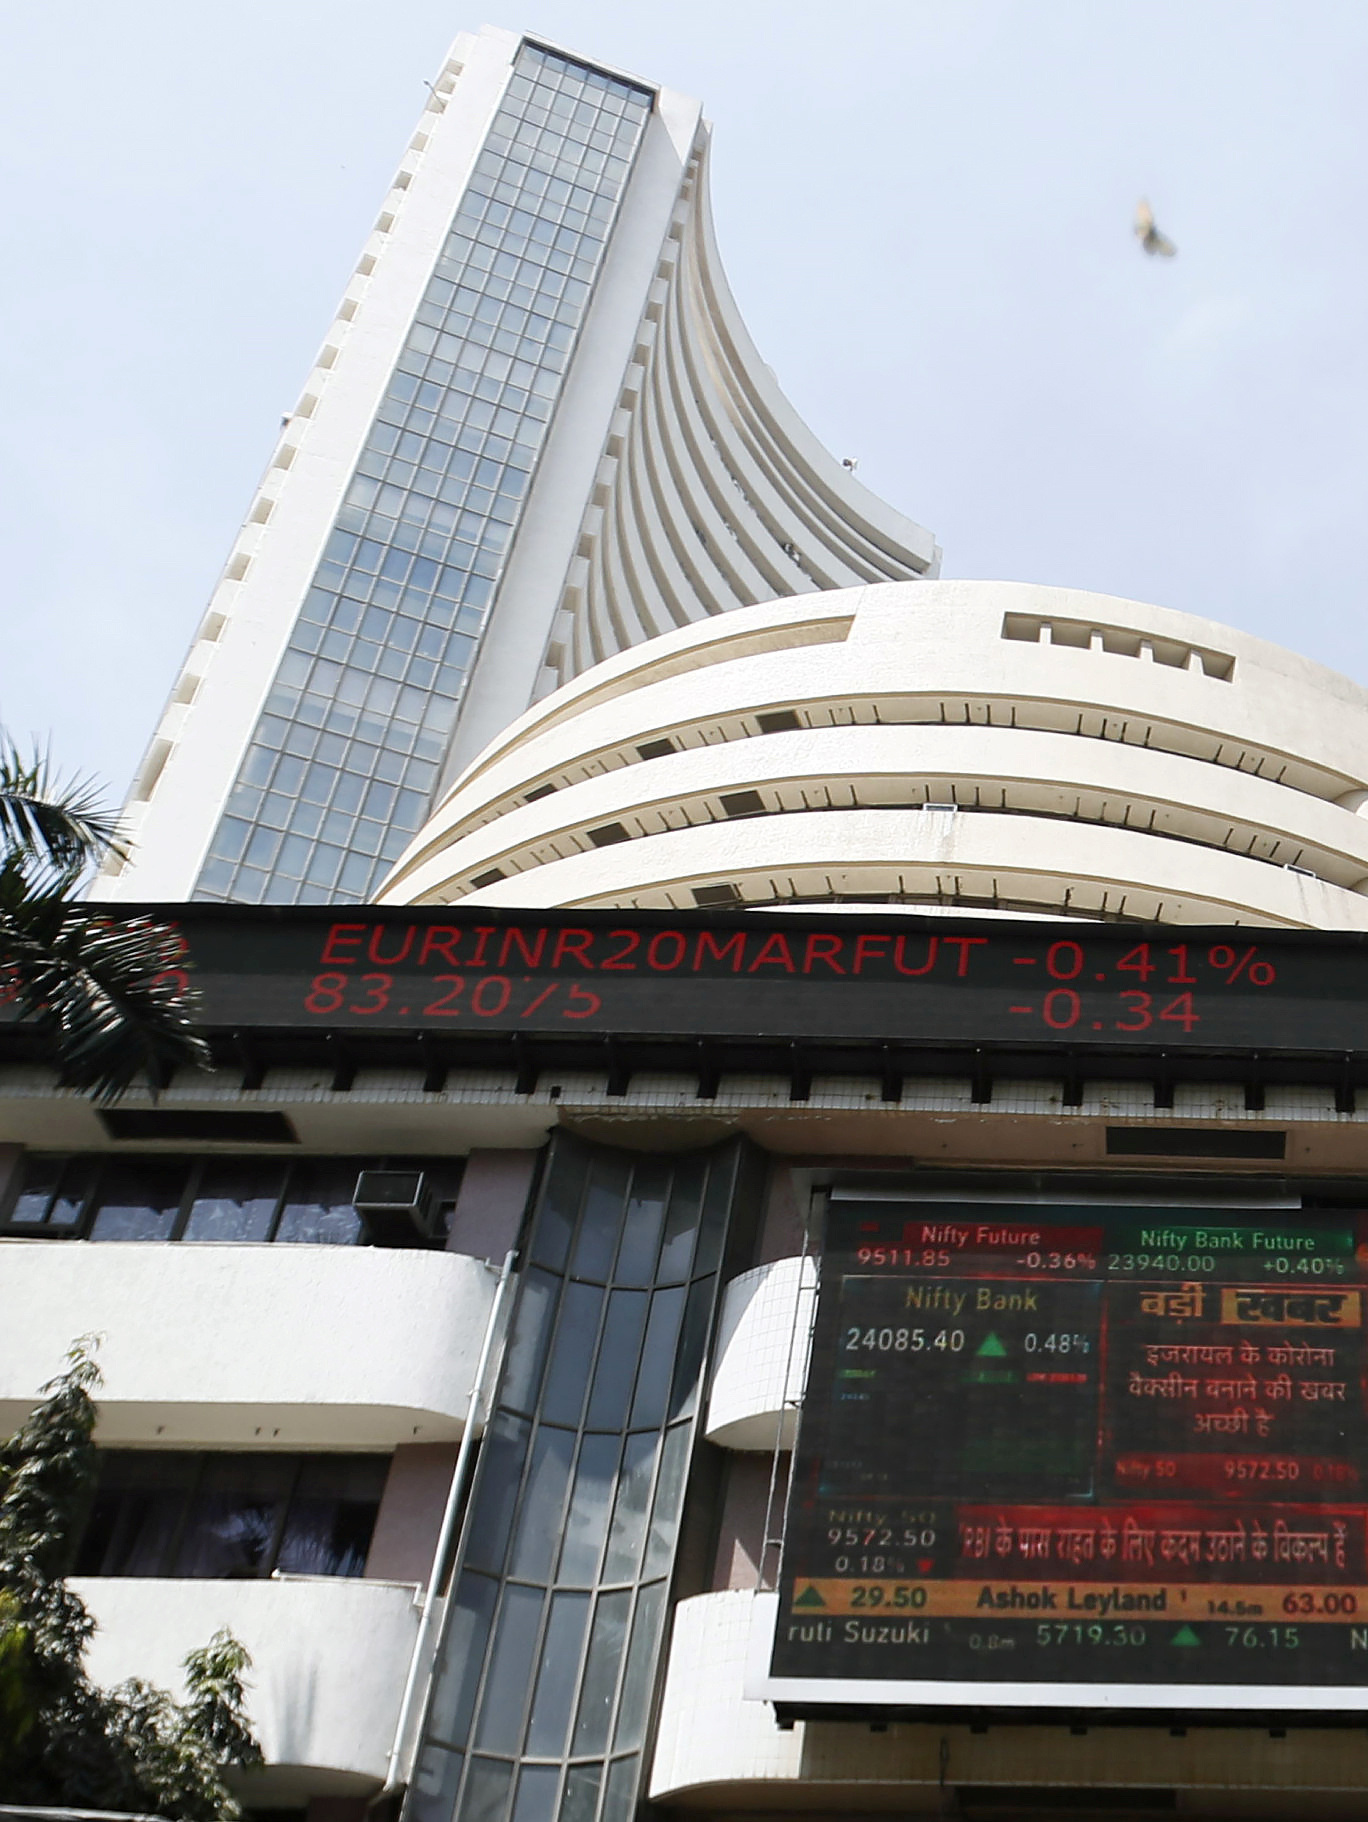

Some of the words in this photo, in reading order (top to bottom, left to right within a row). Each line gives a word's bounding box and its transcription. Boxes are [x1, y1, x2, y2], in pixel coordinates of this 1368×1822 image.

[321, 924, 988, 976] EURINR20MARFUT
[1014, 941, 1276, 986] -0.41%
[1010, 988, 1200, 1031] -0.34
[922, 1225, 969, 1246] Nifty
[976, 1227, 1041, 1246] Future
[1141, 1230, 1188, 1251] Nifty
[1196, 1232, 1243, 1249] Bank
[1252, 1233, 1316, 1250] Future
[857, 1248, 951, 1267] 9511.85
[1017, 1252, 1096, 1270] -0.36%
[1108, 1254, 1216, 1272] 23940.00
[1264, 1258, 1344, 1276] +0.40%
[905, 1286, 967, 1316] Nifty
[976, 1288, 1039, 1311] Bank
[846, 1328, 965, 1352] 24085.40
[1024, 1333, 1091, 1354] 0.48%
[1240, 1339, 1260, 1366] के
[1263, 1373, 1293, 1401] की
[1255, 1408, 1275, 1438] है
[1224, 1461, 1300, 1480] 9572.50
[827, 1528, 936, 1547] 9572.50
[850, 1585, 927, 1609] 29.50
[976, 1585, 1058, 1609] Ashok
[1067, 1587, 1168, 1616] Leyland
[1283, 1591, 1358, 1616] 63.00
[788, 1620, 832, 1642] ruti
[844, 1621, 929, 1644] Suzuki
[1036, 1624, 1147, 1647] 5719.30
[1226, 1627, 1300, 1650] 76.15
[1350, 1628, 1368, 1651] N
